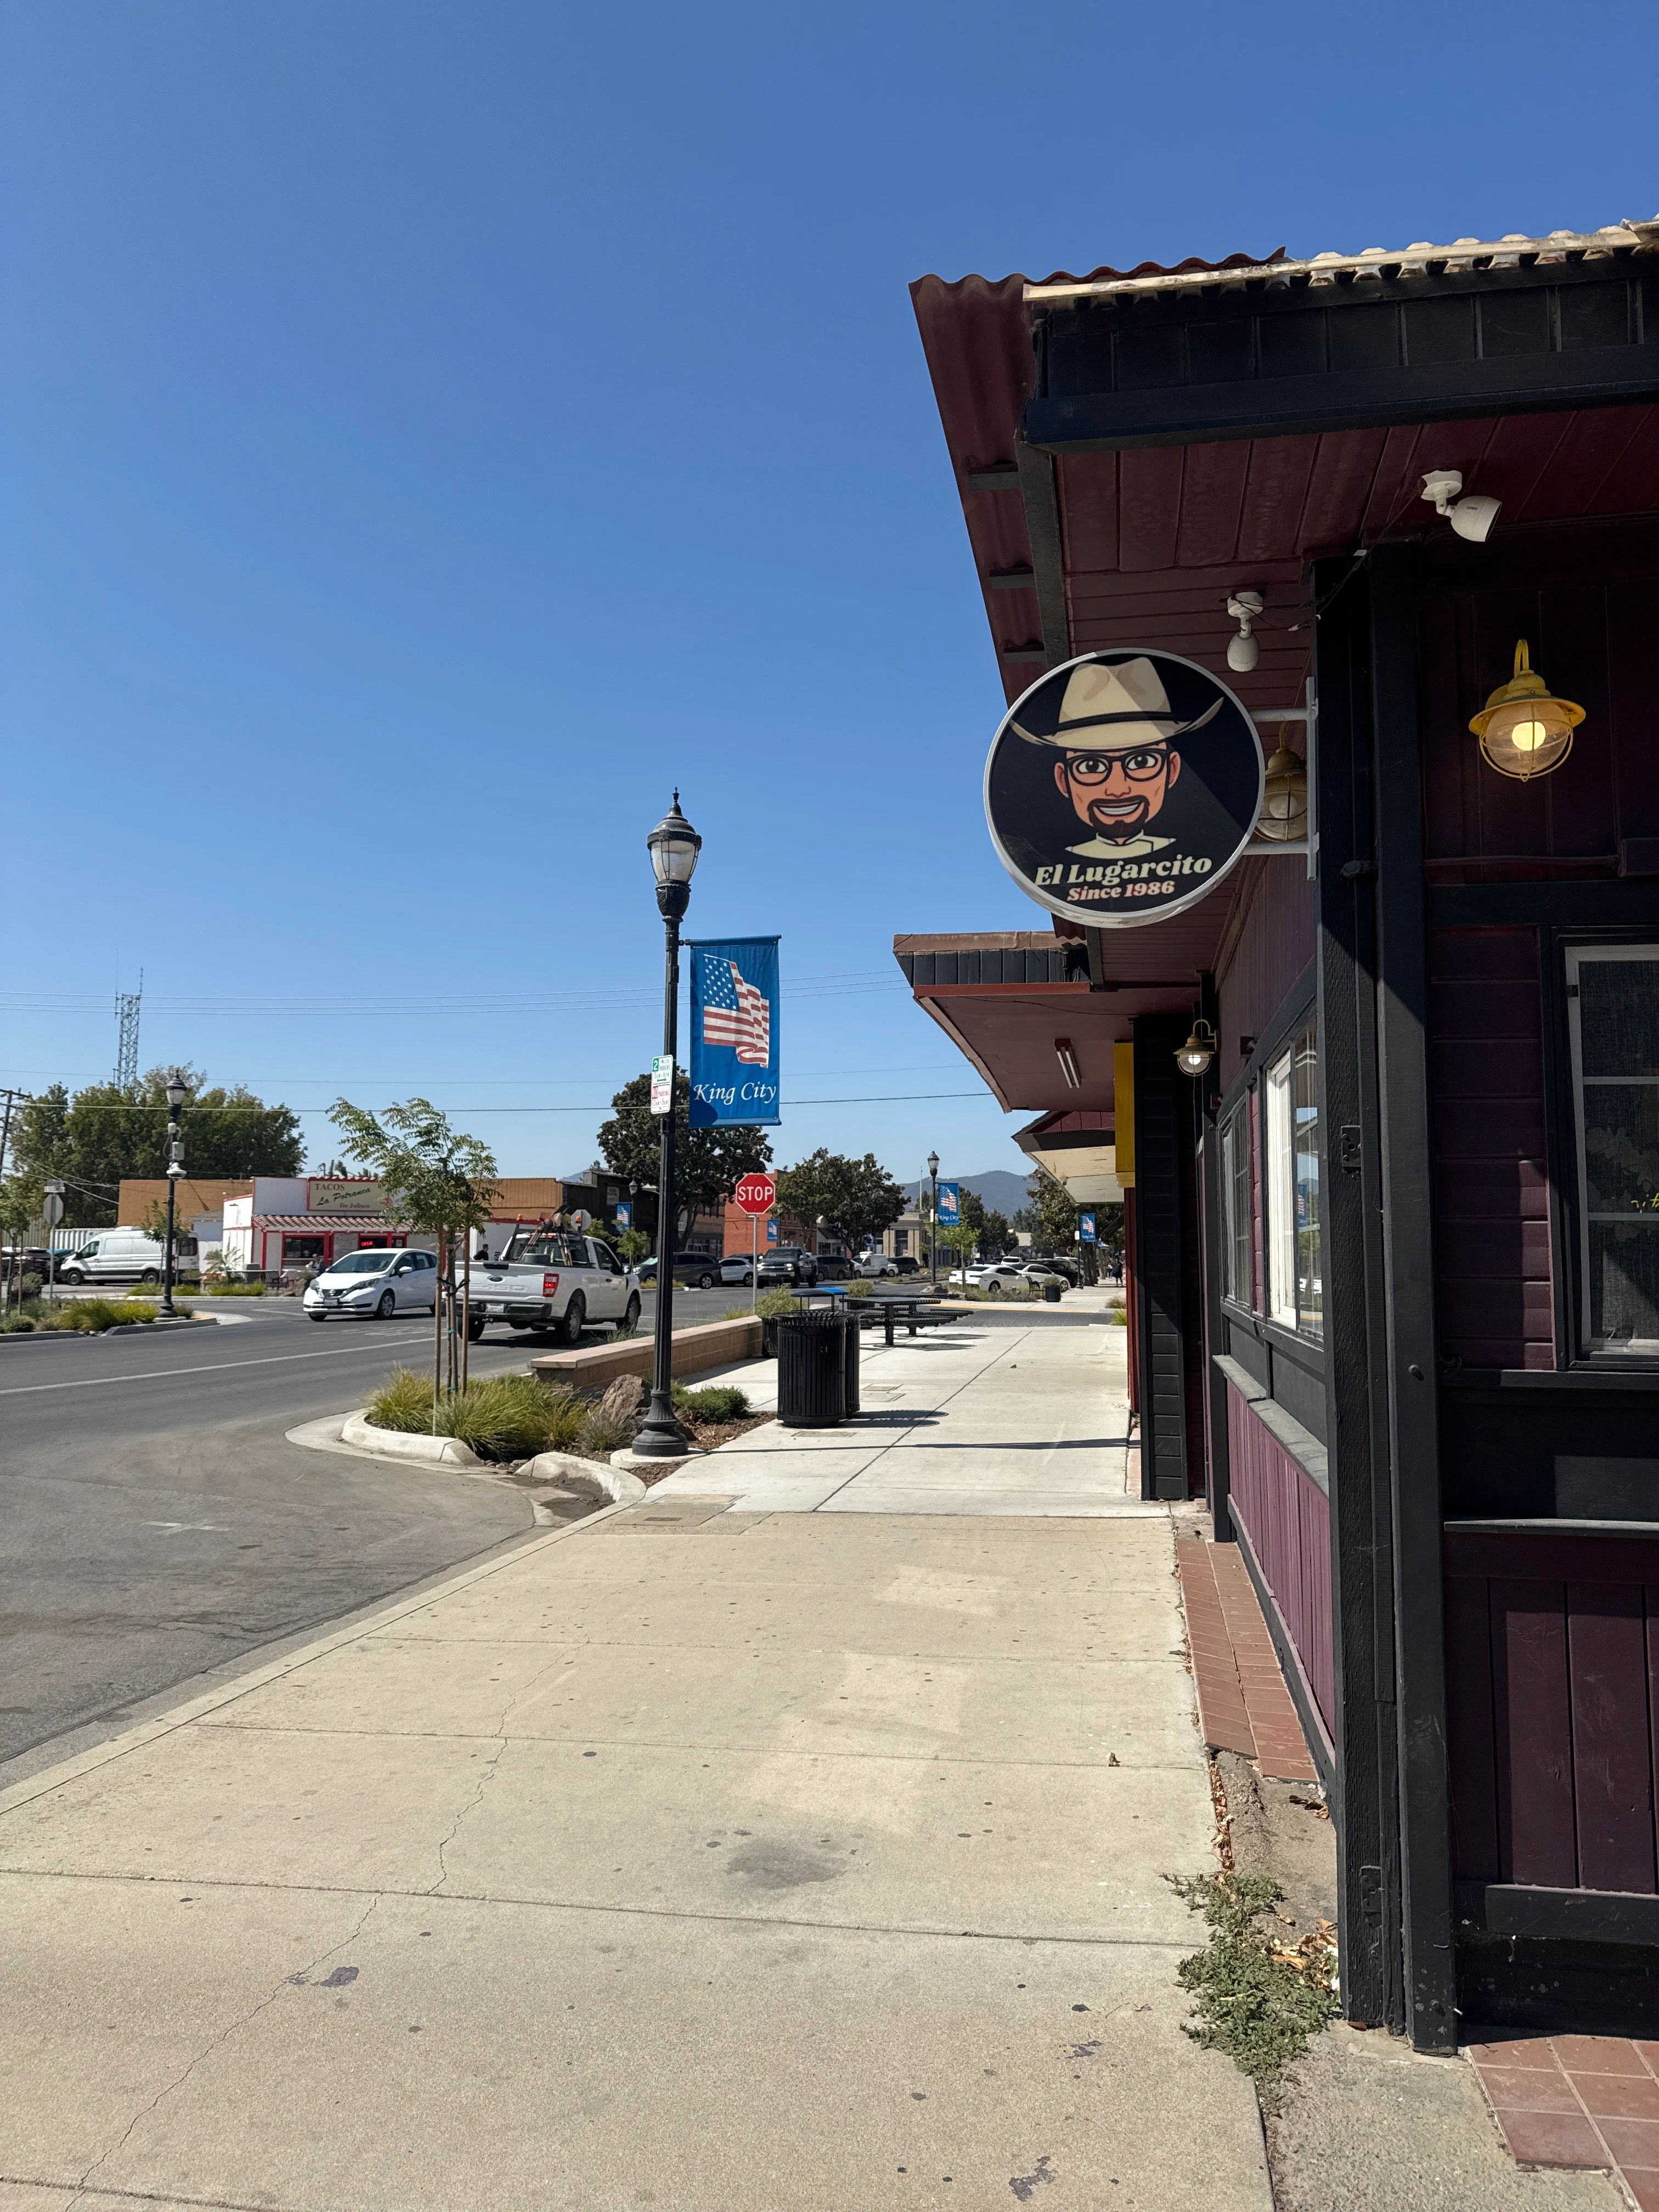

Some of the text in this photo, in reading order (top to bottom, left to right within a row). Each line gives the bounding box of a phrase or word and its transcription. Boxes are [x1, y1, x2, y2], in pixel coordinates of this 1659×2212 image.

[1035, 854, 1212, 886] El Lugarcito
[1067, 881, 1176, 901] Since 1986
[653, 1060, 658, 1070] 2
[693, 1081, 776, 1105] King City
[317, 1188, 371, 1206] La Potranca
[738, 1186, 773, 1201] STOP
